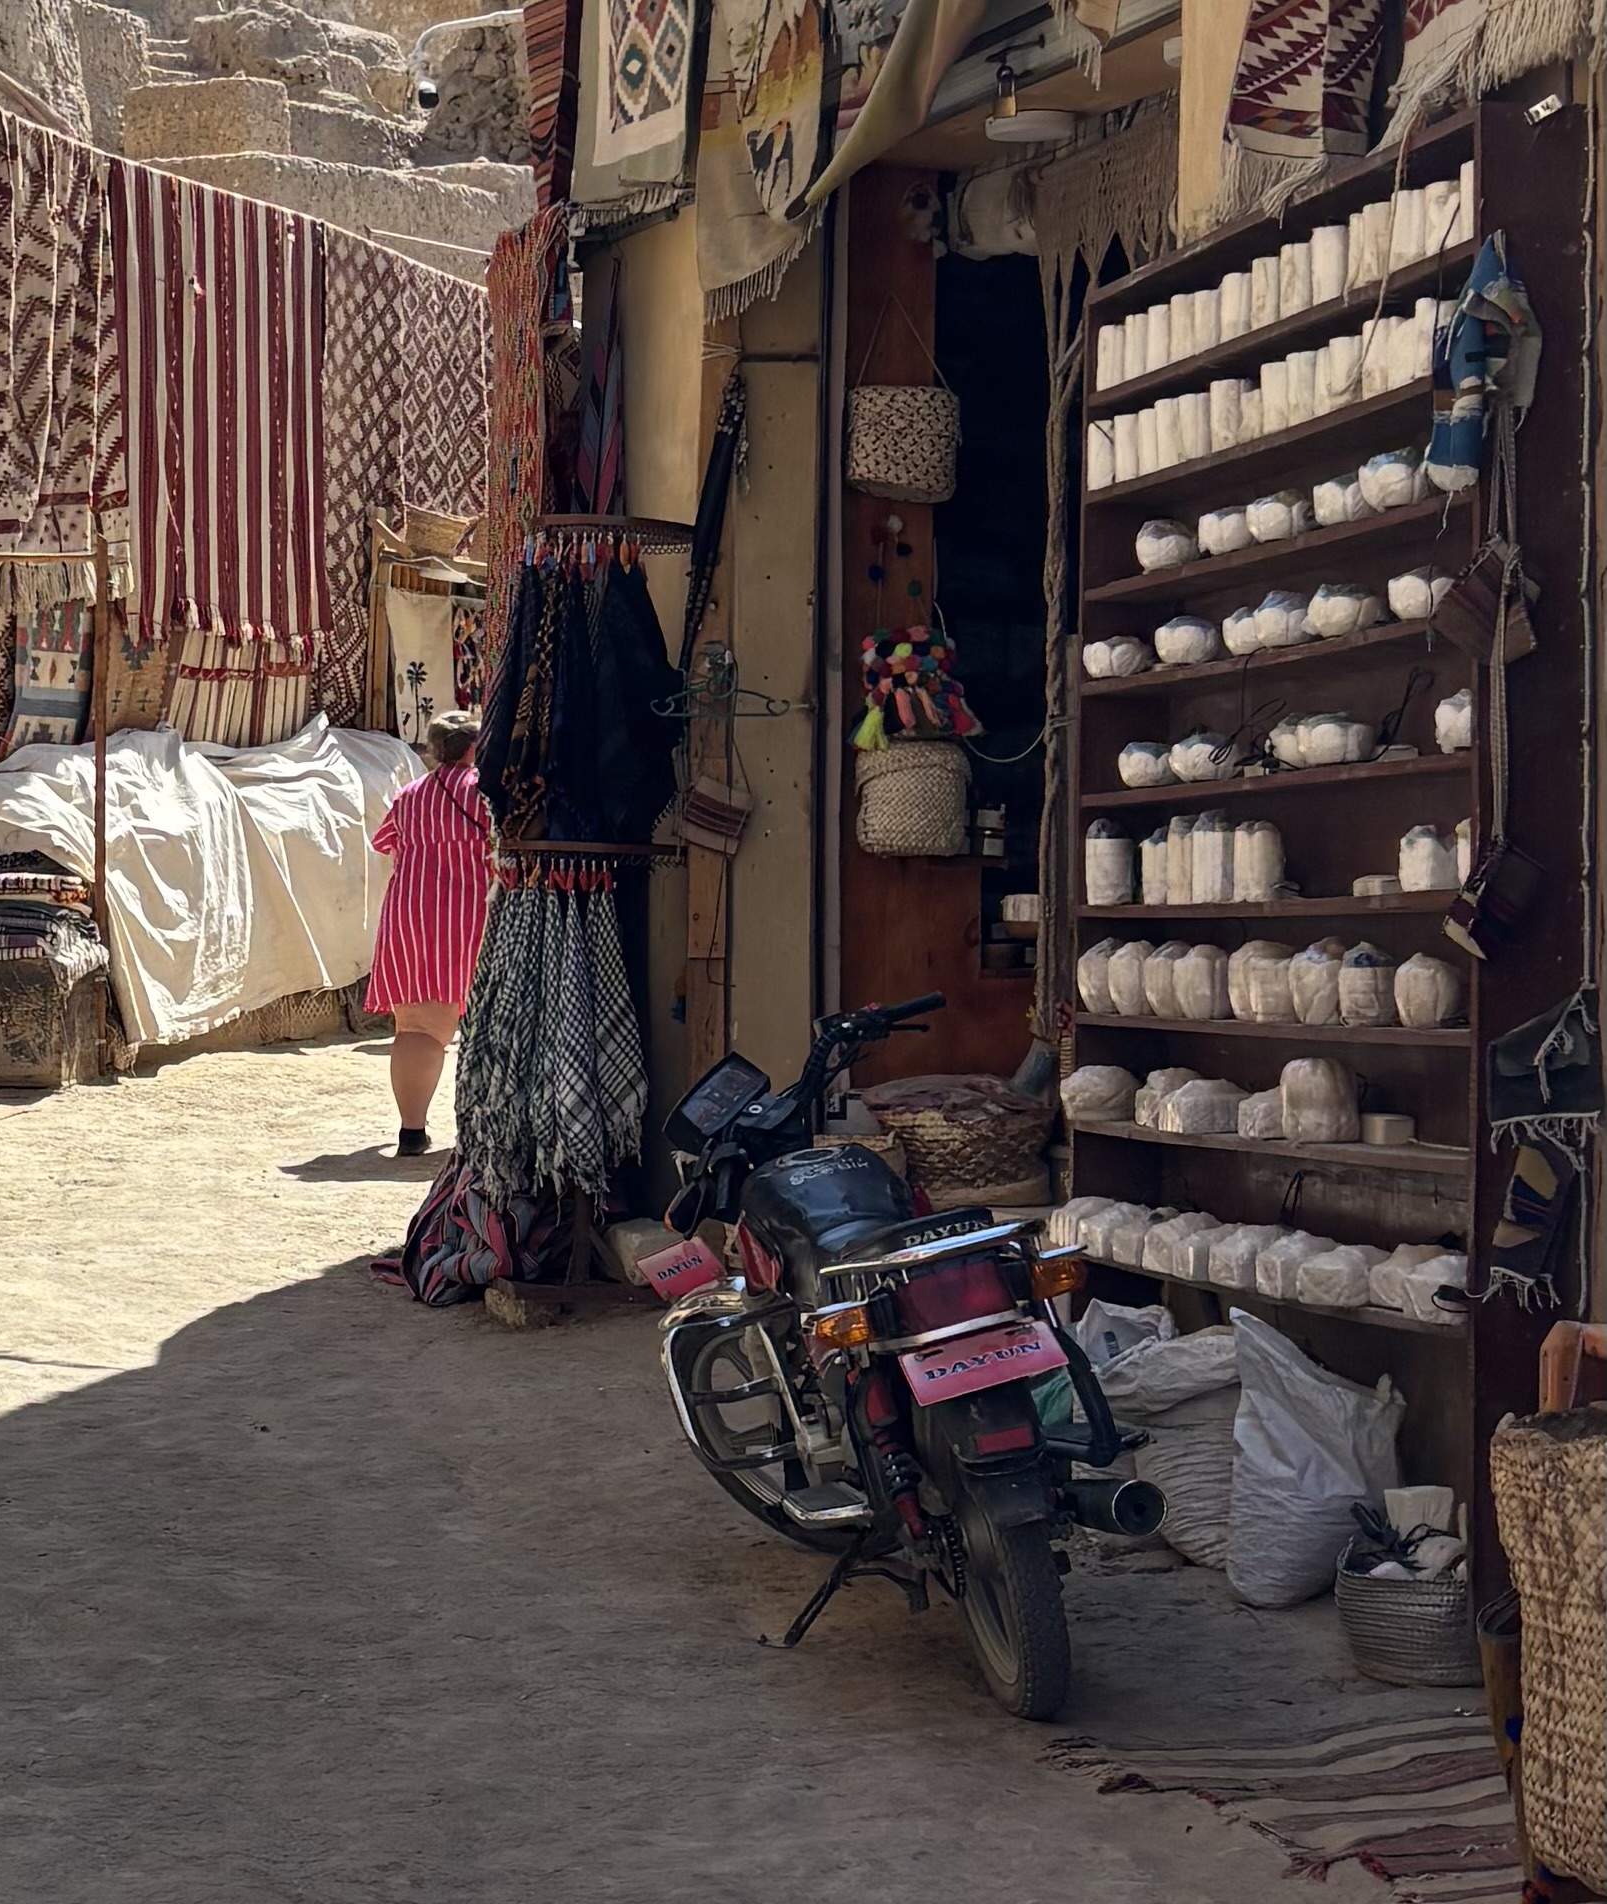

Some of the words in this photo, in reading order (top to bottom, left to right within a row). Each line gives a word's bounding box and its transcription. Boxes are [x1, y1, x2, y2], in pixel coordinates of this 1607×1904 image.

[902, 1220, 990, 1248] DAYUN
[657, 1255, 703, 1280] DAYUN
[923, 1341, 1041, 1381] DAYUN
